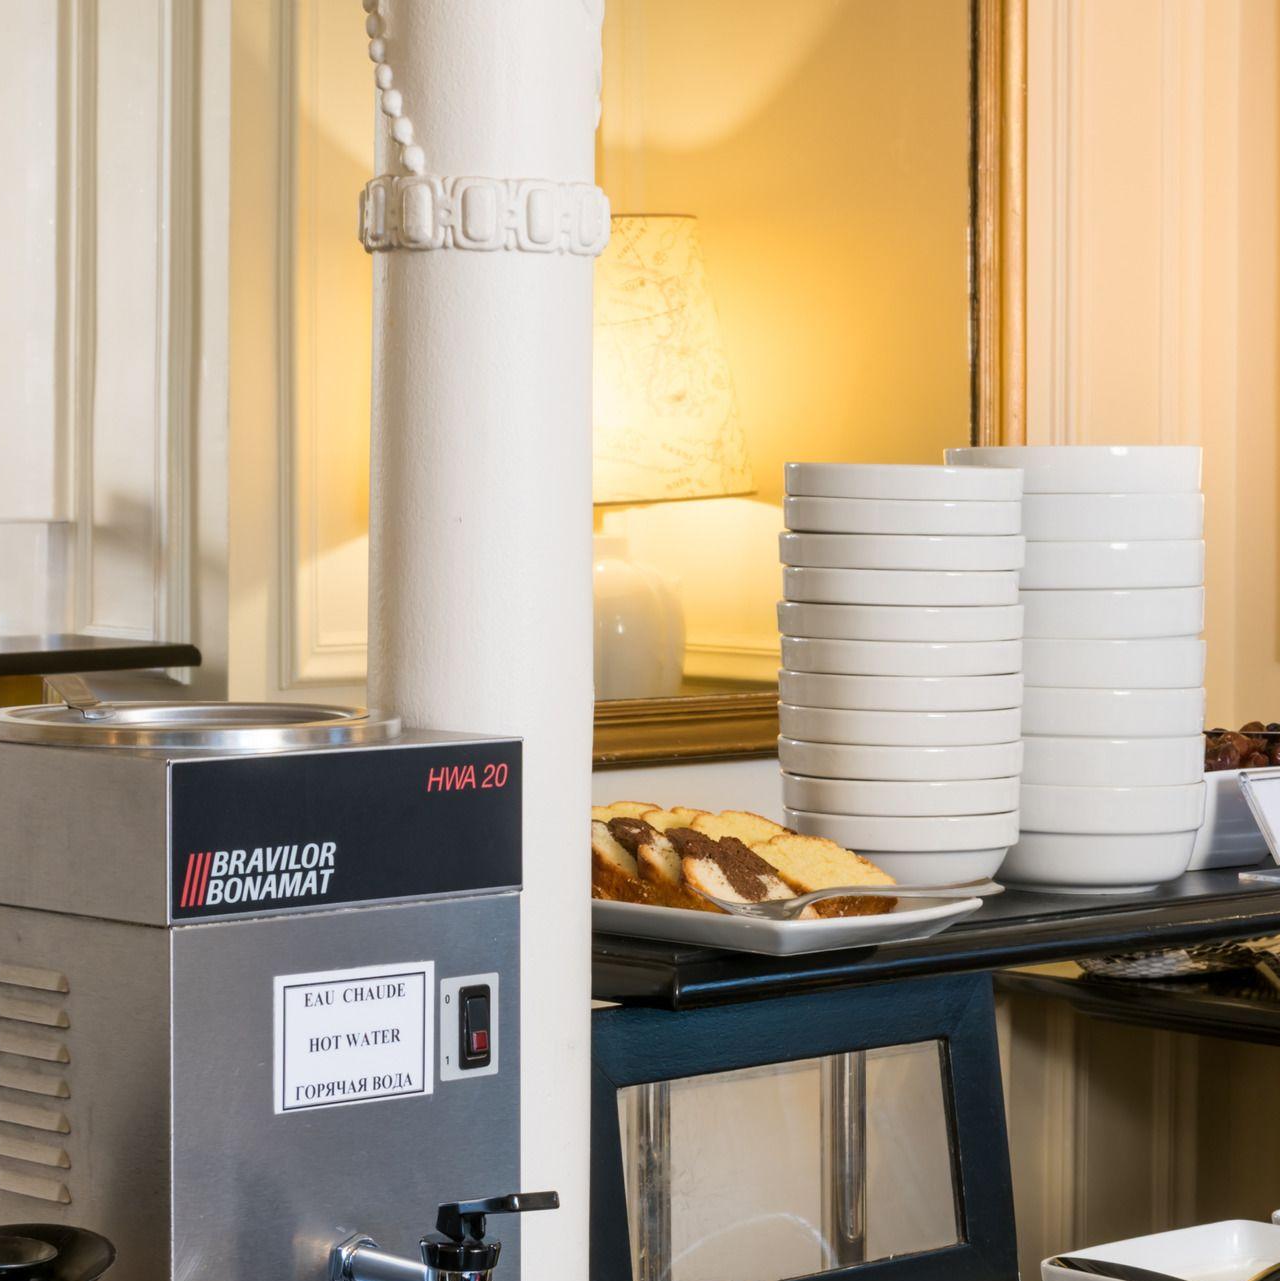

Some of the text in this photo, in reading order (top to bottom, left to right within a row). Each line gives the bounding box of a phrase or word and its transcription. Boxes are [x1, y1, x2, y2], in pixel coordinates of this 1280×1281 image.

[427, 763, 508, 792] HWA 20
[211, 842, 337, 877] BRAVILOR
[206, 868, 334, 906] BONAMAT
[304, 982, 406, 1009] EAU CHAUDE
[309, 1028, 401, 1054] HOT WATER
[295, 1072, 414, 1102] ГОРЯЧАЯ ВОДА
